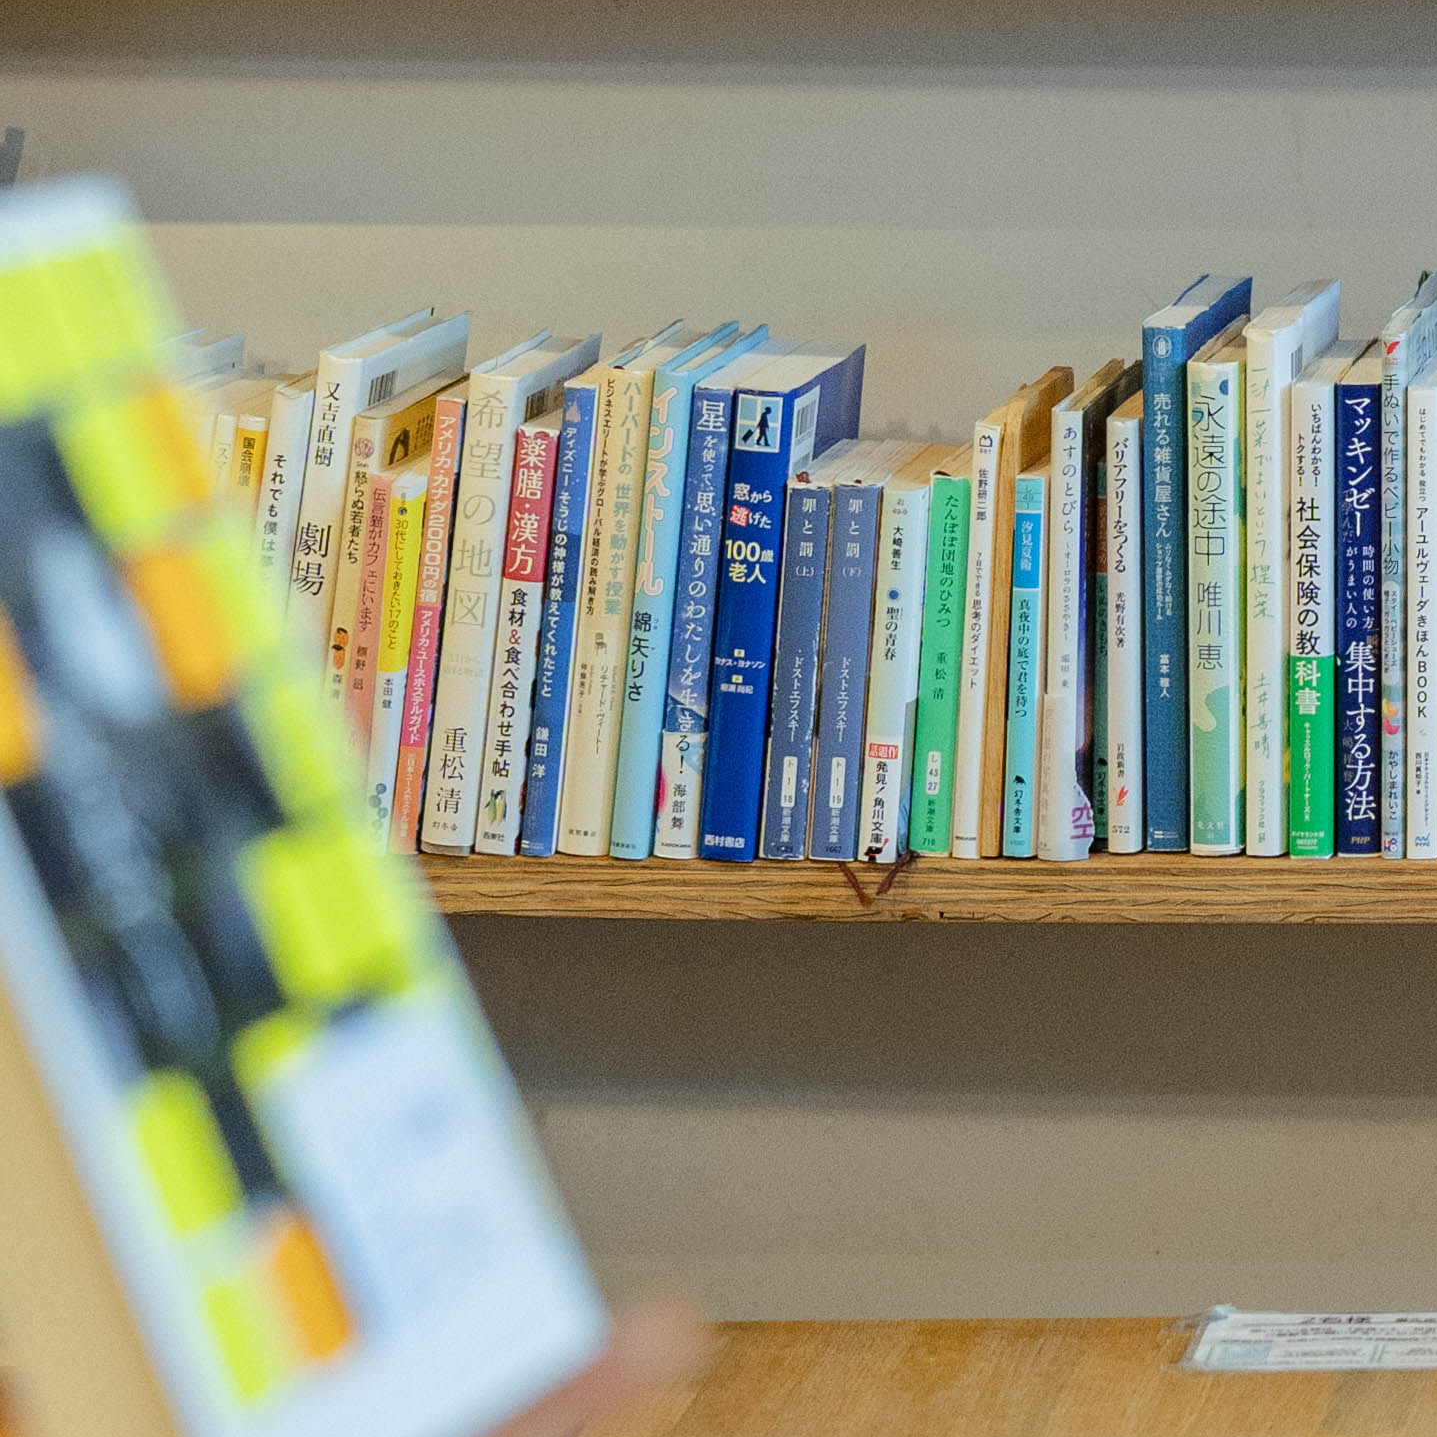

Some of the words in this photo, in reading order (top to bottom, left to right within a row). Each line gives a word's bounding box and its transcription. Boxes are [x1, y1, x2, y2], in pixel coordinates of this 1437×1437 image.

[314, 380, 341, 468] 又吉直樹
[634, 386, 675, 597] インストール
[1060, 425, 1078, 537] あすのとびら
[1191, 395, 1228, 567] 永遠の途中
[293, 520, 331, 596] 劇場
[797, 497, 816, 560] 罪と罰
[628, 610, 652, 703] 綿矢りさ
